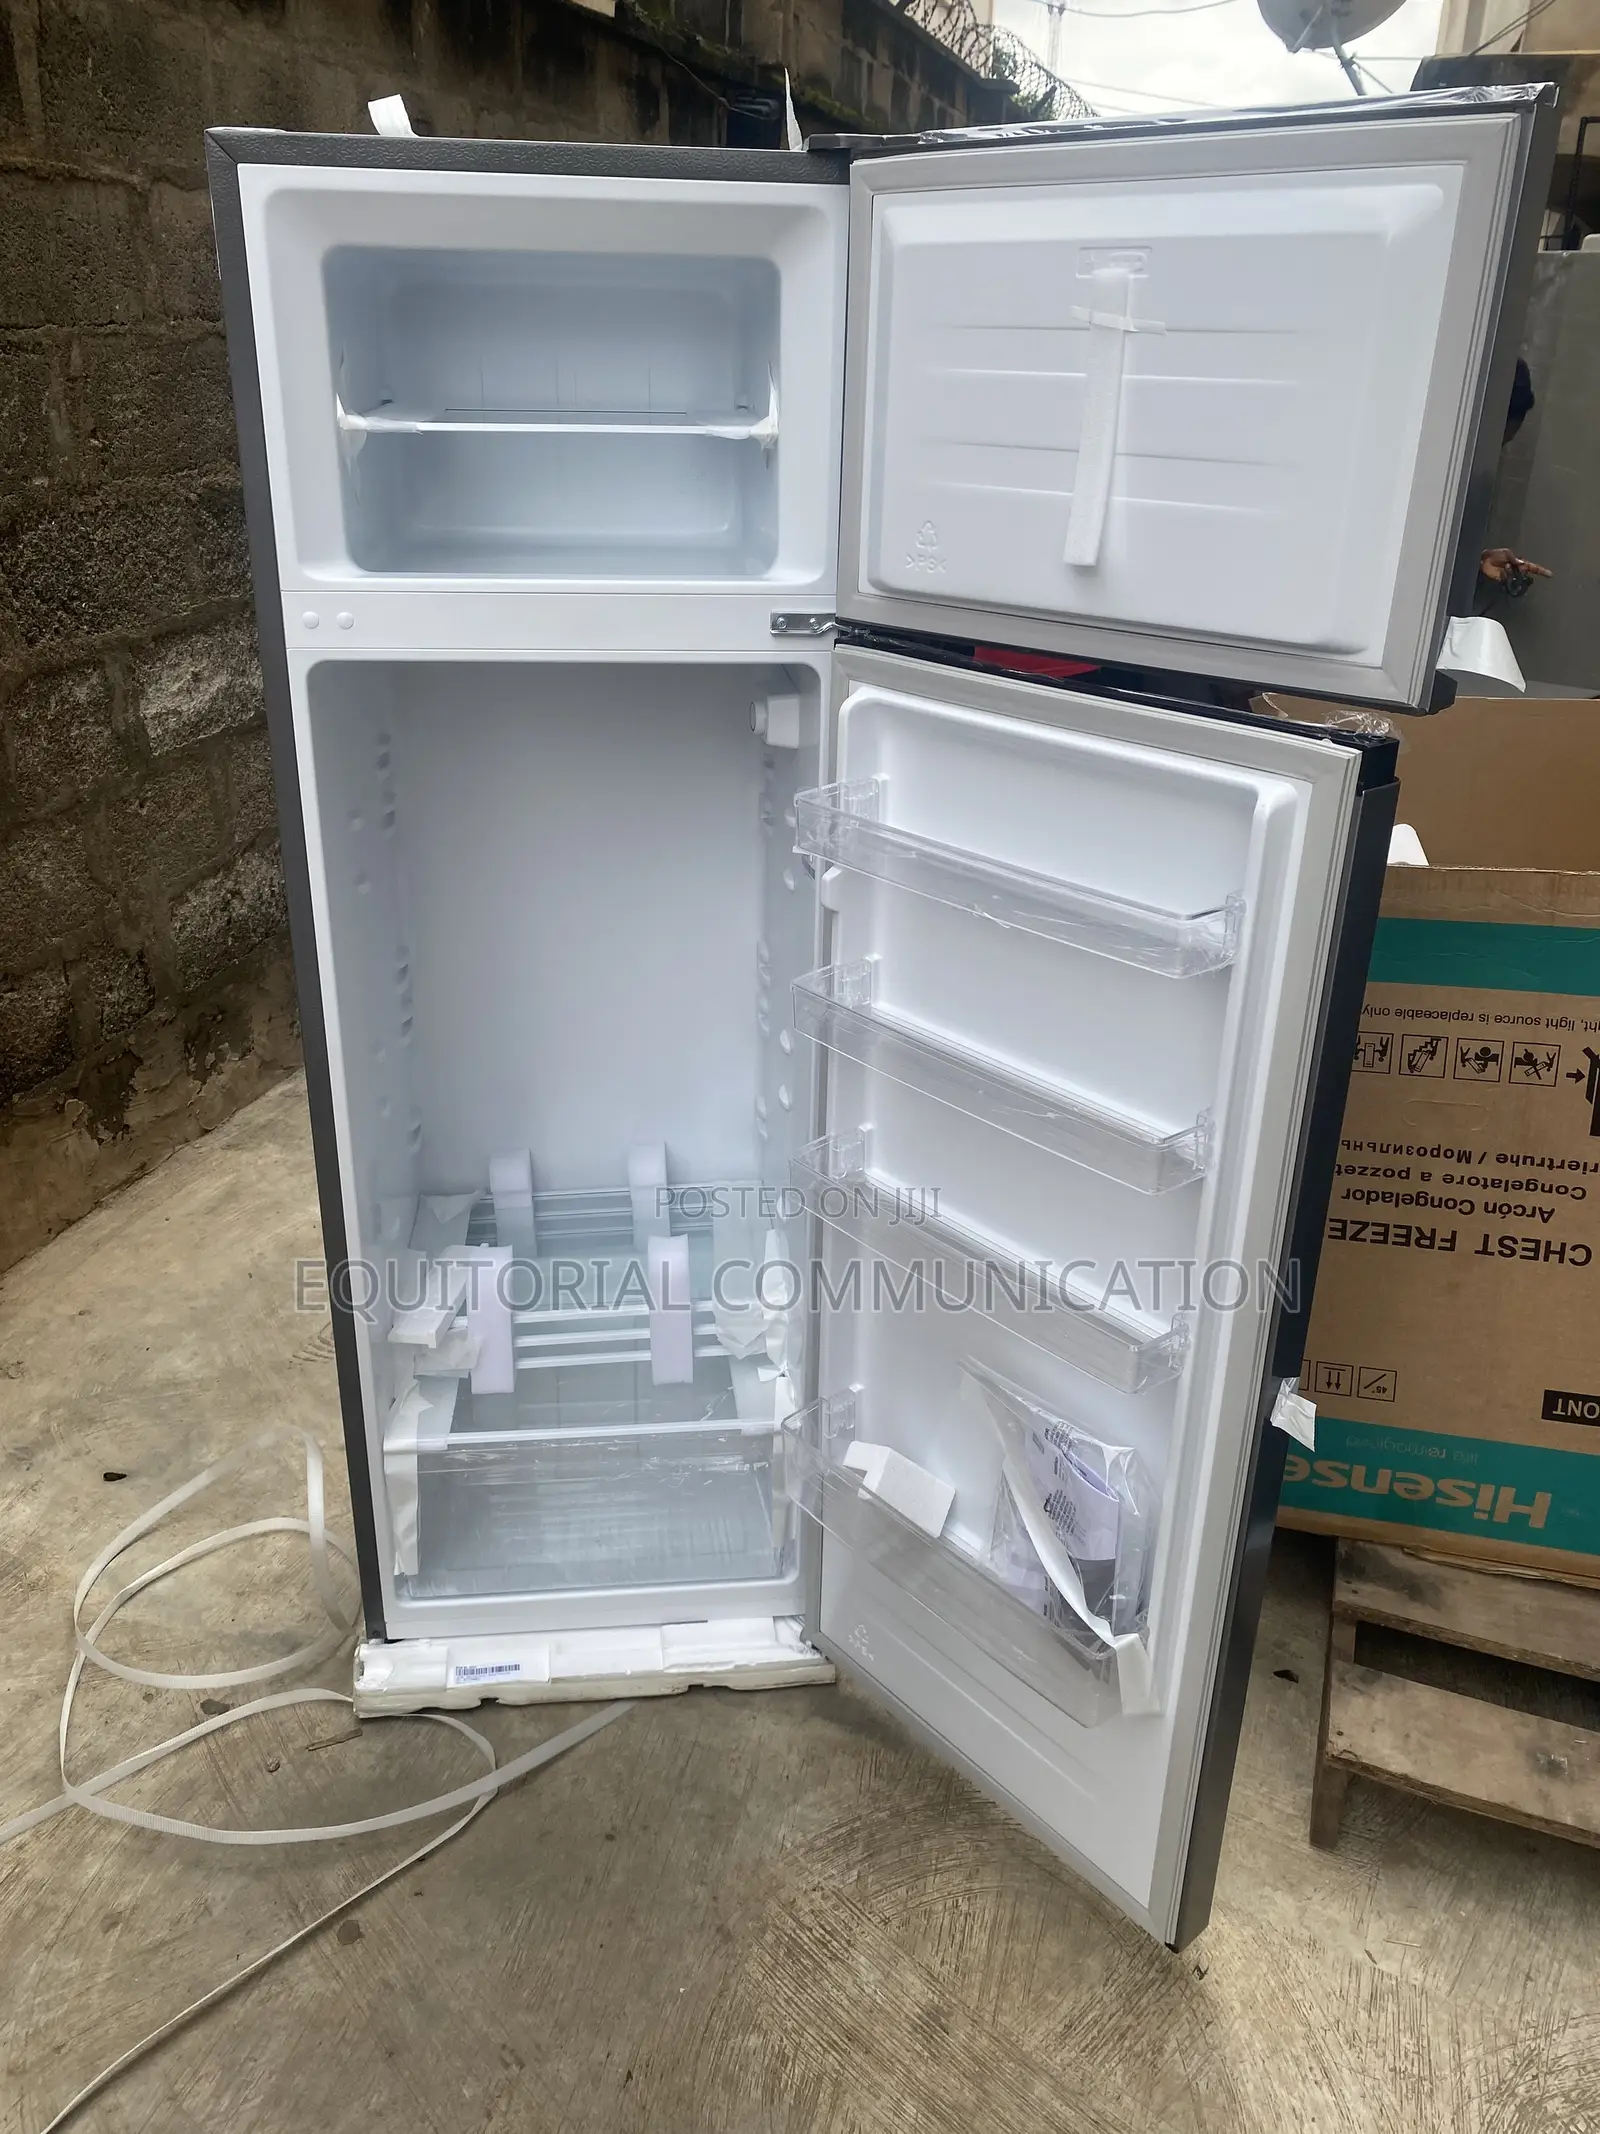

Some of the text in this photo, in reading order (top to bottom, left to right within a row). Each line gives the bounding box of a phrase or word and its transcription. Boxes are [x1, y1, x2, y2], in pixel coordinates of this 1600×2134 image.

[1361, 1004, 1391, 1018] only
[1394, 1006, 1475, 1022] replaceable
[1478, 1012, 1490, 1024] is
[1494, 1014, 1541, 1027] source
[1545, 1016, 1575, 1032] light
[1335, 1163, 1587, 1200] Congelatore a pozzet
[1341, 1188, 1556, 1224] Arcón Congelador
[1327, 1218, 1593, 1267] CHEST FREEZE
[1552, 1398, 1600, 1419] ONT
[1283, 1454, 1552, 1529] Hisense
